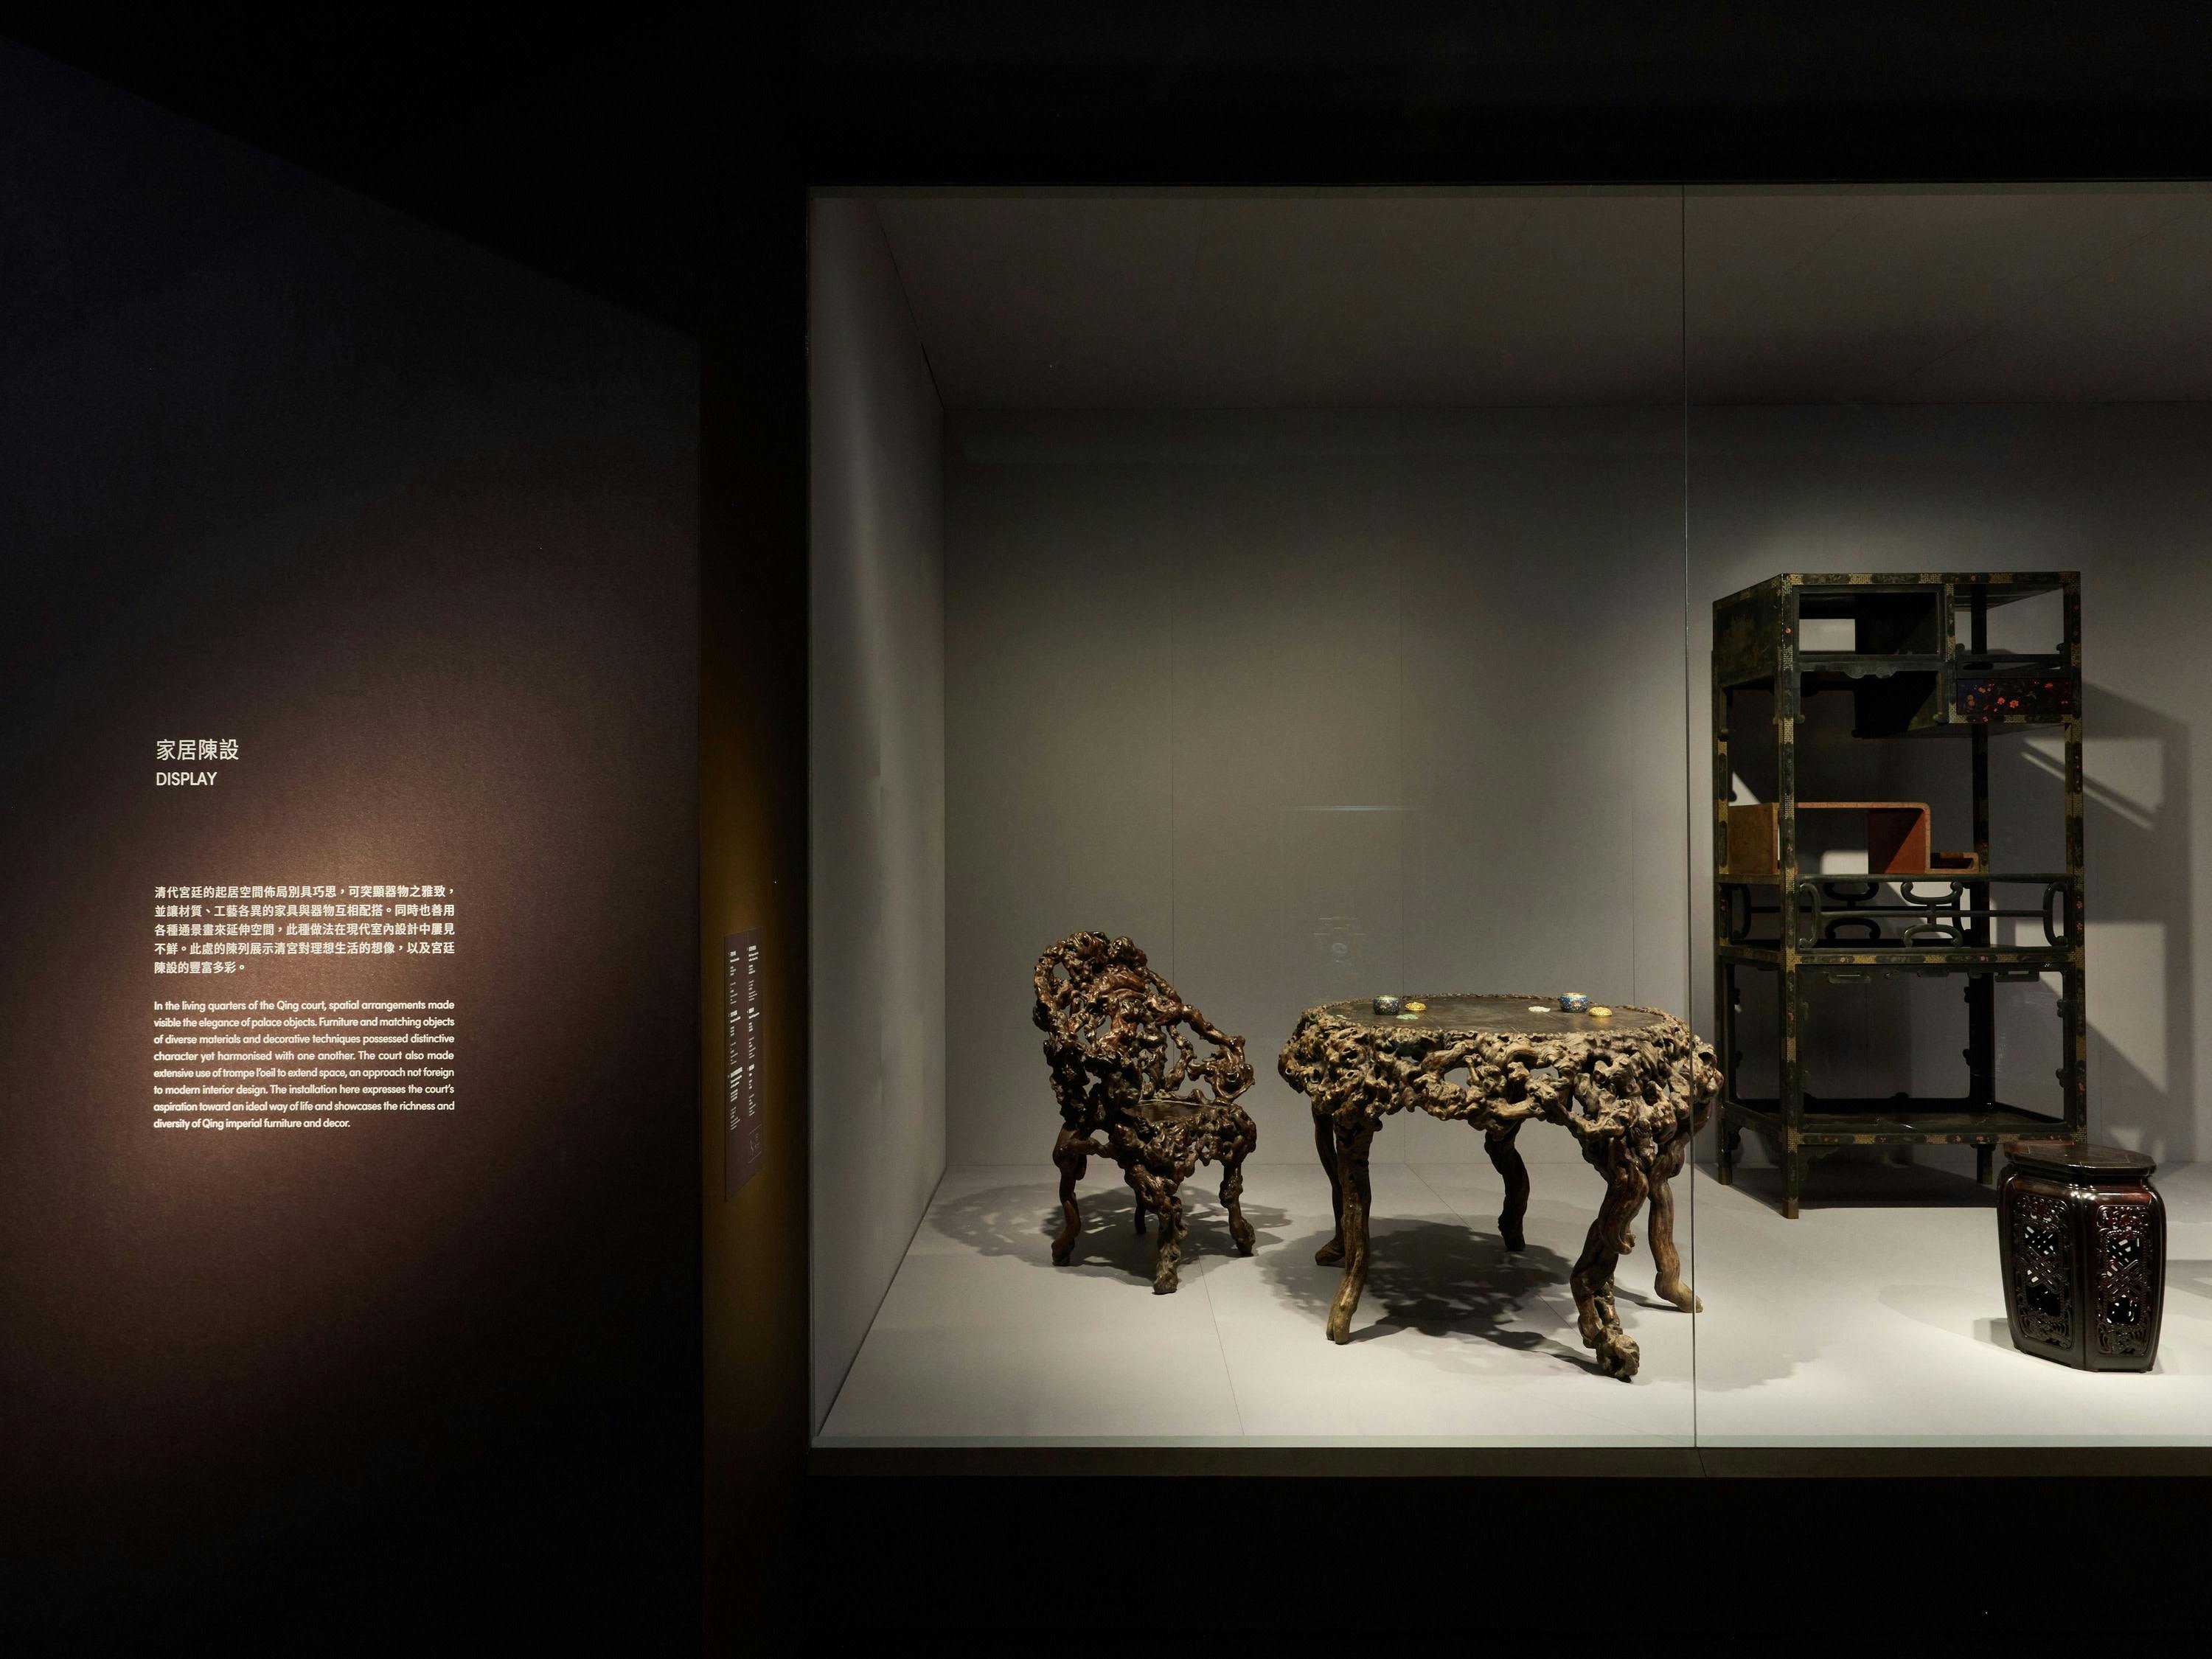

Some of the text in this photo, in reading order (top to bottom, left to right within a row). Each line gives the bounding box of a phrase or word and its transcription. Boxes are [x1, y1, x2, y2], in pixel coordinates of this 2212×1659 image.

[156, 738, 239, 761] 家居陳設
[156, 771, 218, 786] DISPLAY
[154, 961, 246, 974] 陳設的豐富多彩。
[154, 999, 455, 1013] In the living quarters of the Qing court, spatial arrangements made
[153, 1016, 455, 1030] visible the elegance of palace objects. Furniture and matching objects
[153, 1033, 455, 1046] of diverse materials and decorative techniques possessed distinctive
[153, 1051, 199, 1061] character
[201, 1051, 215, 1063] yet
[218, 1051, 272, 1061] harmonised
[274, 1051, 294, 1062] with
[317, 1050, 356, 1060] another.
[358, 1050, 376, 1060] The
[378, 1051, 403, 1060] court
[405, 1050, 425, 1060] also
[427, 1050, 455, 1060] made
[153, 1068, 194, 1078] extensive
[212, 1068, 222, 1077] of
[223, 1068, 255, 1079] trompe
[257, 1068, 276, 1077] l’oeil
[277, 1068, 286, 1077] to
[288, 1067, 318, 1077] extend
[319, 1070, 347, 1079] space,
[362, 1067, 406, 1079] approach
[407, 1068, 422, 1077] not
[422, 1067, 455, 1079] foreign
[153, 1083, 455, 1097] to modern interior design. The installation here expresses the court’s
[153, 1102, 198, 1113] aspiration
[199, 1101, 231, 1111] toward
[246, 1101, 268, 1111] ideal
[269, 1104, 288, 1113] way
[289, 1101, 299, 1111] of
[300, 1101, 313, 1111] life
[315, 1101, 333, 1111] and
[334, 1101, 382, 1111] showcases
[383, 1101, 398, 1110] the
[400, 1101, 436, 1110] richness
[437, 1100, 455, 1110] and
[153, 1118, 351, 1131] diversity of Qing imperial furniture and decor.
